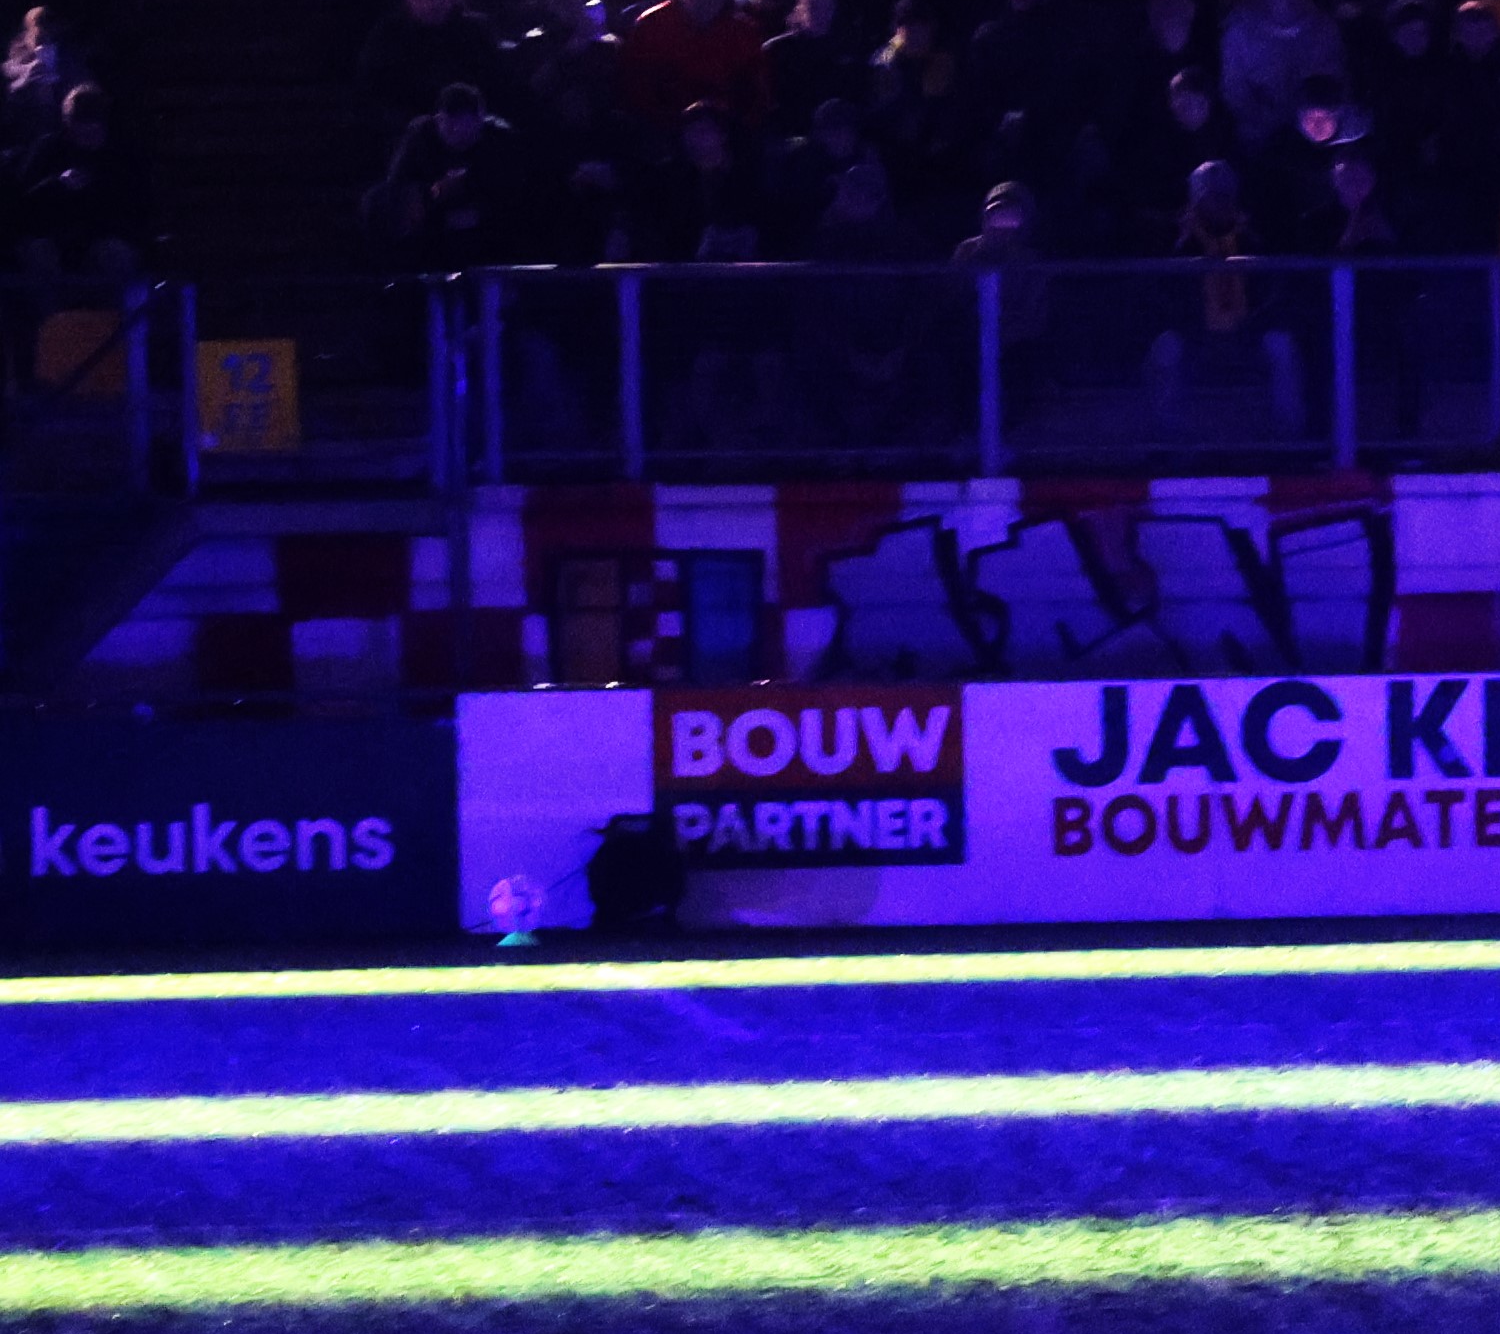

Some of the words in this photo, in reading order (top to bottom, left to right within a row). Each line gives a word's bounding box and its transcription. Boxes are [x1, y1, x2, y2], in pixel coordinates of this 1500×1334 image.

[671, 705, 951, 778] BOUW
[1051, 678, 1343, 787] JAC
[30, 803, 395, 877] keukens
[674, 798, 949, 852] PARTNER
